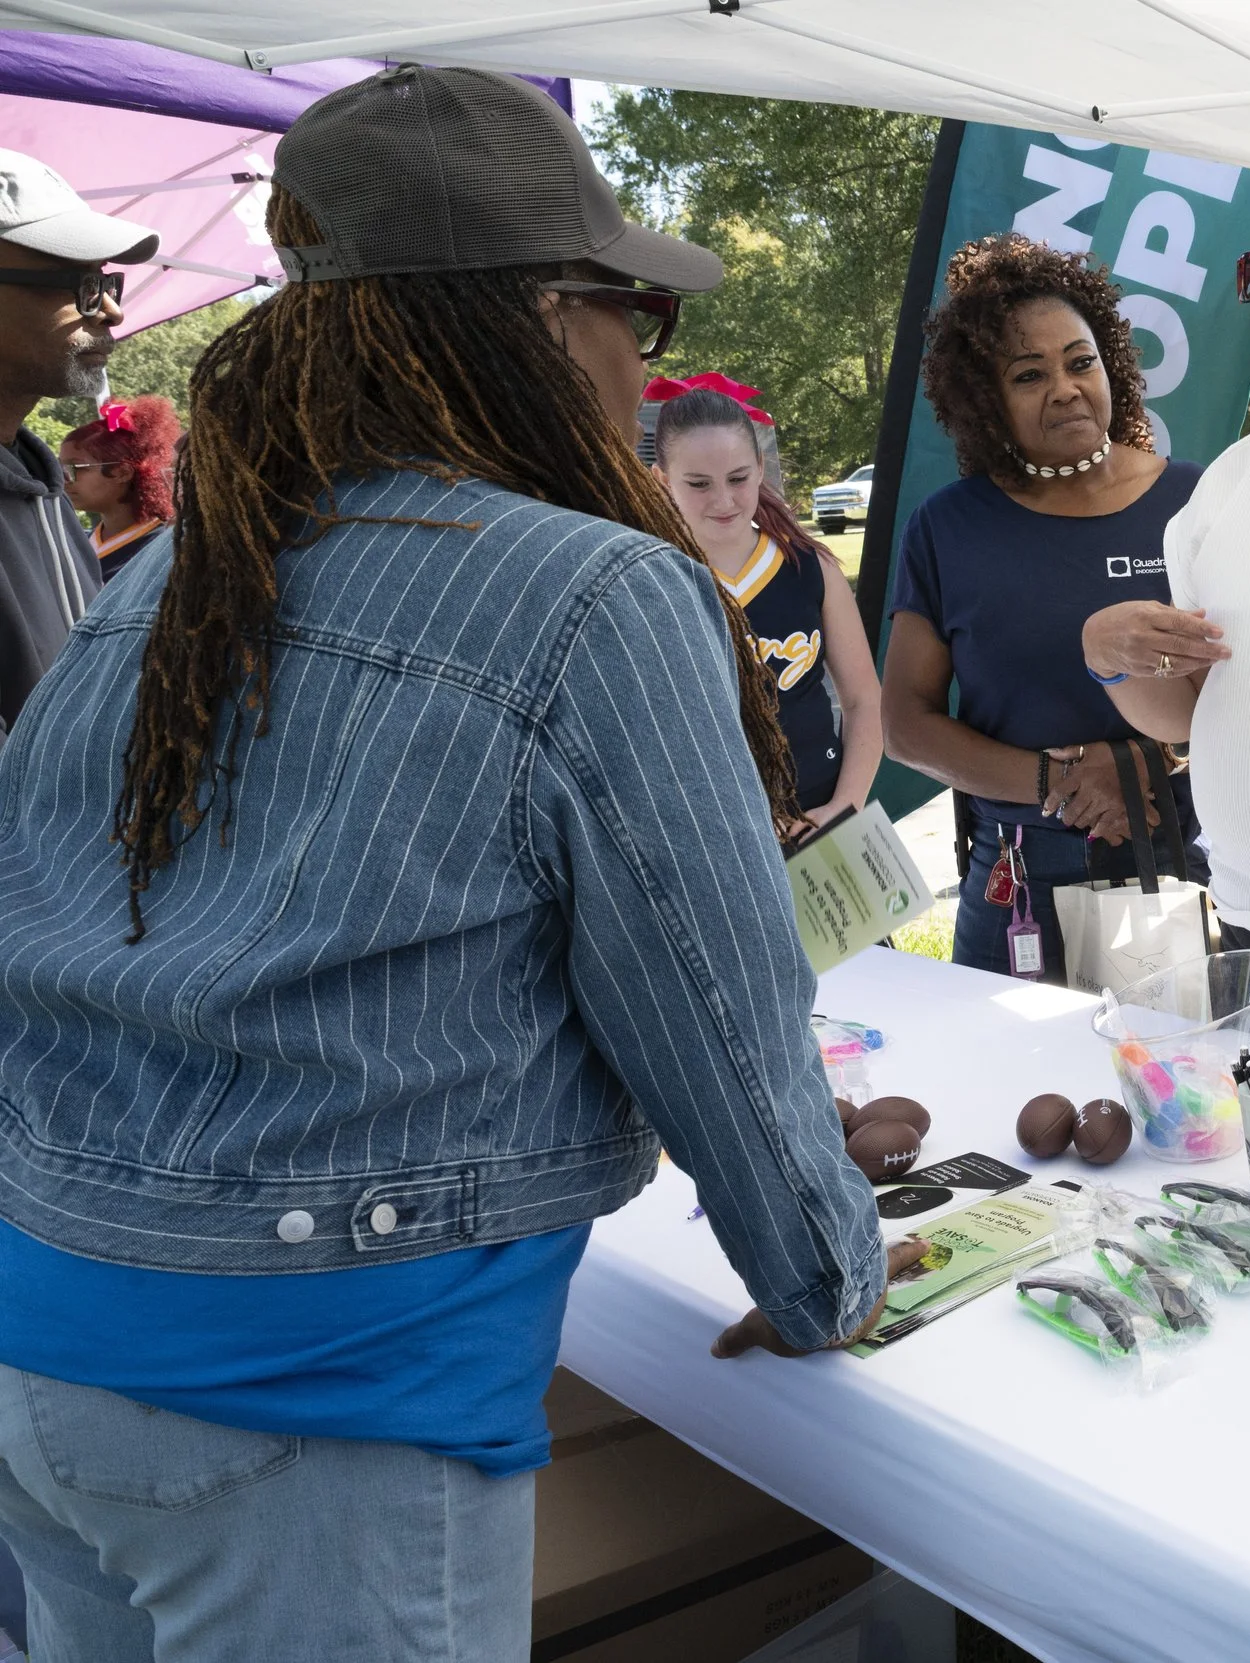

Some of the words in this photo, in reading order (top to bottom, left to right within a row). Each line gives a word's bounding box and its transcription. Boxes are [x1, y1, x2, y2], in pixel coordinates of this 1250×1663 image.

[964, 1211, 985, 1219] Save
[990, 1210, 1026, 1225] Program
[995, 1220, 1032, 1236] Upgrade
